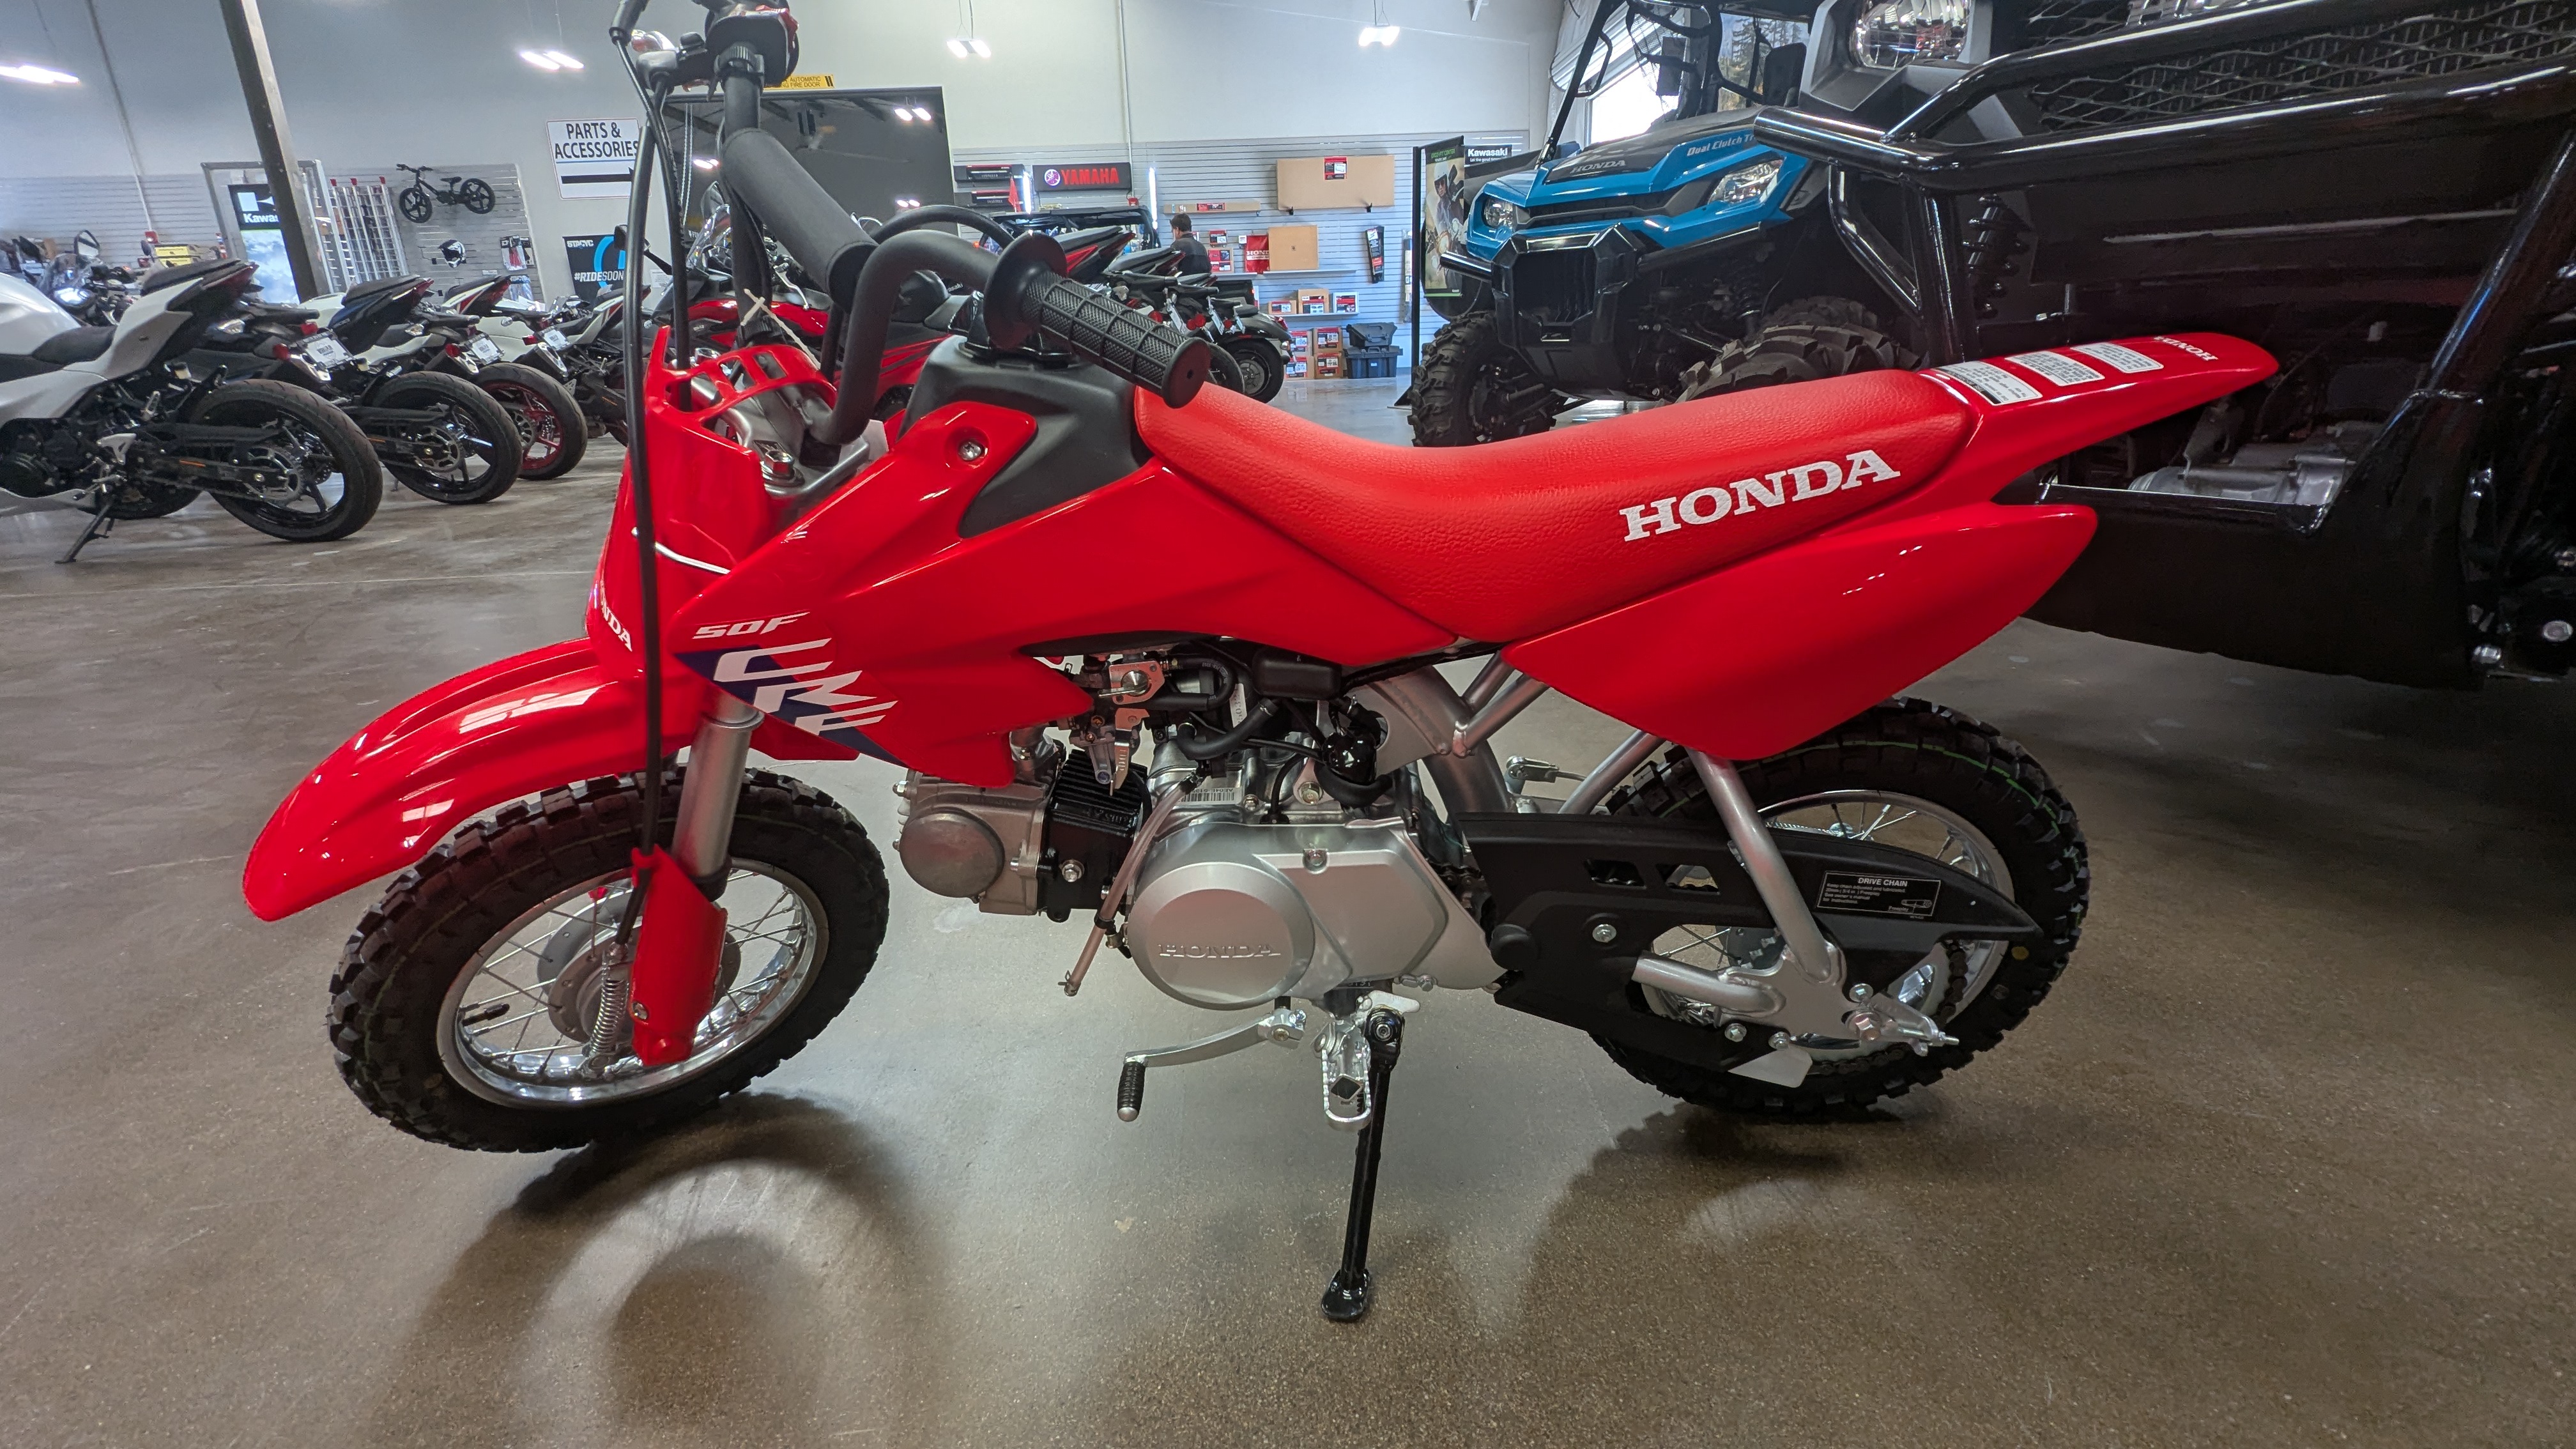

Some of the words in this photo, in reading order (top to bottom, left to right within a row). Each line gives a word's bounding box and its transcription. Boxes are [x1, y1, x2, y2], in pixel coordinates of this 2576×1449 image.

[566, 122, 608, 139] PARTS
[611, 122, 622, 138] &
[1468, 148, 1508, 157] Kawasaki
[1687, 142, 1711, 157] Dual
[1712, 136, 1743, 150] Clutch
[1570, 160, 1626, 174] HONDA
[1061, 167, 1119, 185] YAMAHA
[566, 240, 594, 248] STACYC
[574, 271, 624, 282] #RIDESOON
[2153, 336, 2219, 361] HONDA
[1619, 450, 1901, 542] HONDA
[713, 638, 898, 736] CRF
[1858, 877, 1882, 885] DRIVE
[1158, 944, 1281, 958] HONDA
